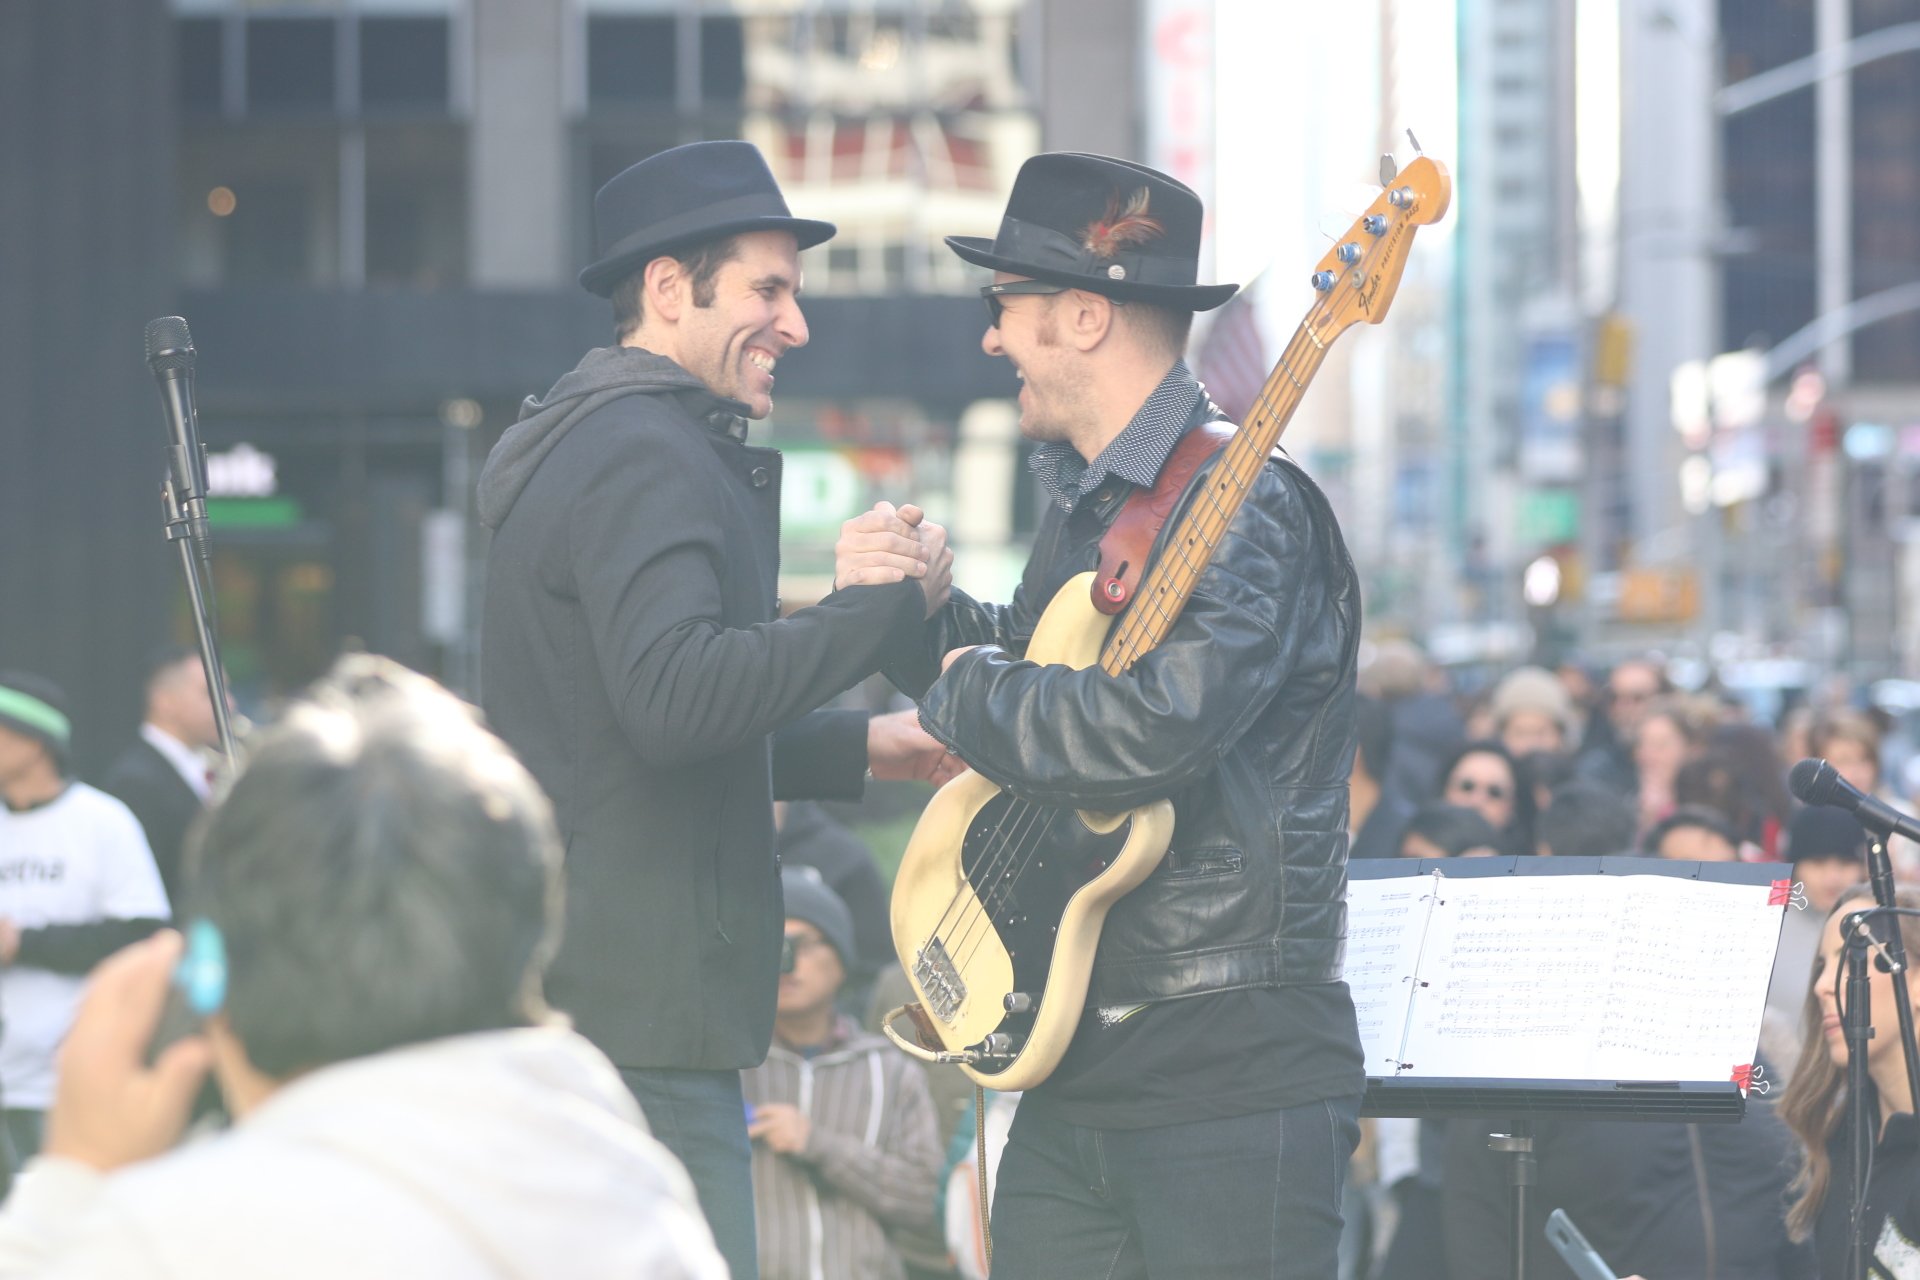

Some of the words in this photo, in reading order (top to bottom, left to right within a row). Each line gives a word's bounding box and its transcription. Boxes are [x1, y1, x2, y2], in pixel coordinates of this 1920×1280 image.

[1358, 272, 1381, 316] Fender
[1381, 223, 1404, 269] PRECISION
[1405, 203, 1420, 221] BASS
